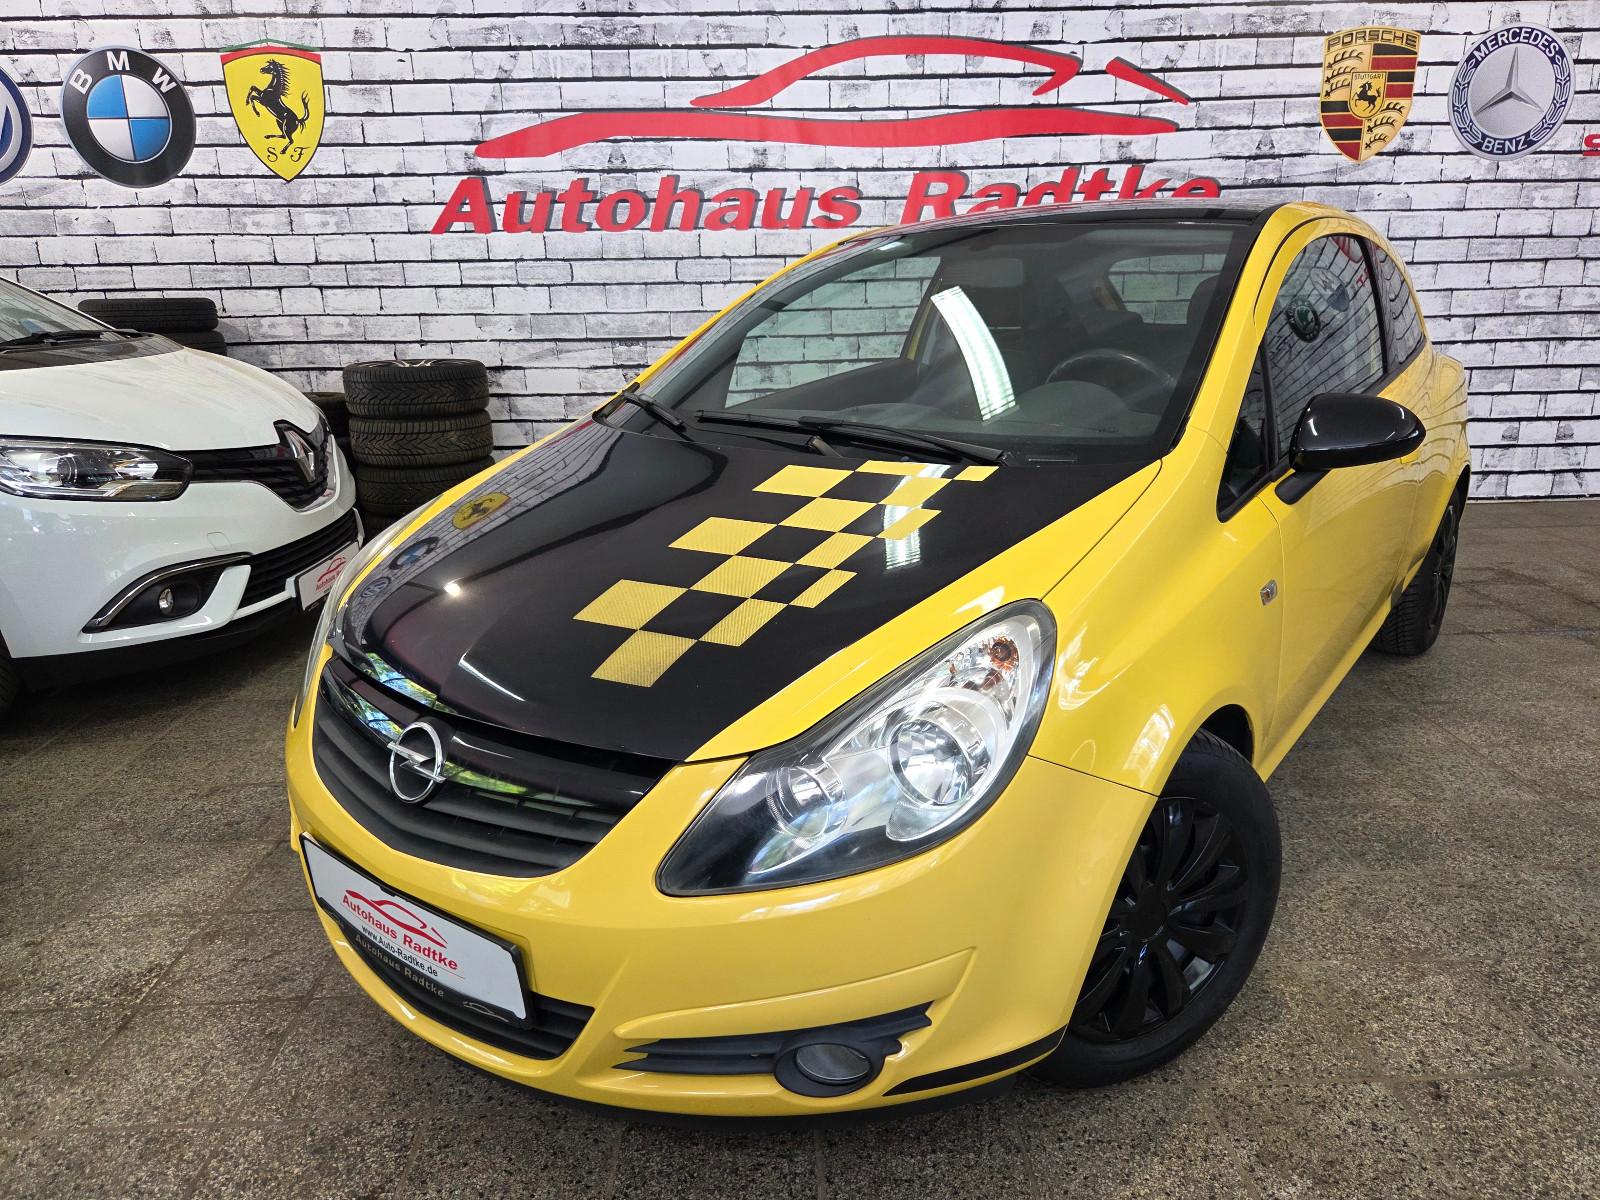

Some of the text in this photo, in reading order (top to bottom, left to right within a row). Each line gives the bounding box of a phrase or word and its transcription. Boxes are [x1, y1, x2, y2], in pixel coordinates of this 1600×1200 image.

[1327, 29, 1418, 52] PORSCHE
[1474, 27, 1560, 61] MERCEDES
[70, 50, 178, 94] BMW
[1481, 136, 1529, 155] BENZ
[430, 174, 863, 235] Autohaus
[342, 894, 459, 970] Autohaus Radtke
[361, 924, 438, 977] www.Auto-Radtke.de
[354, 933, 445, 998] Autohaus Radtke
